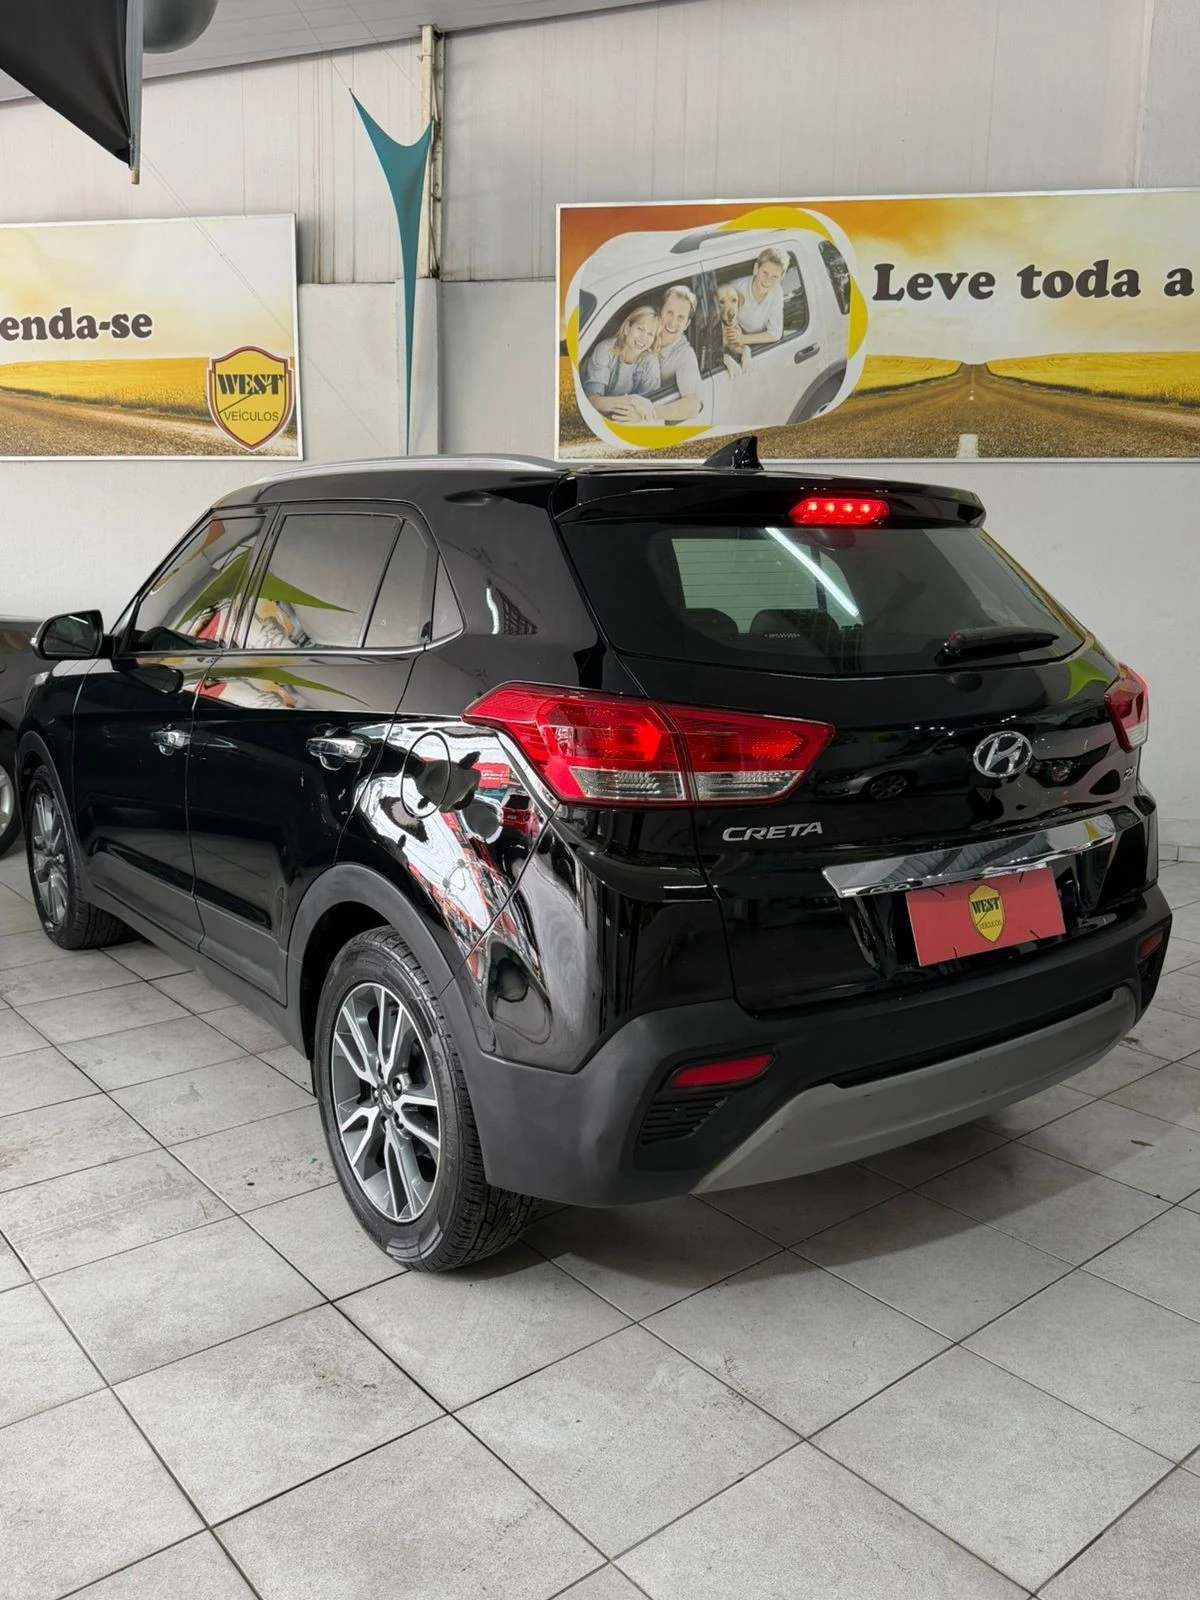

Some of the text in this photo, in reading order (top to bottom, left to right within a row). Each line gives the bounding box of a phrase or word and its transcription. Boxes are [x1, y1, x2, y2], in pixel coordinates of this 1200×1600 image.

[872, 259, 1195, 301] Leve toda a
[0, 306, 153, 341] enda-se
[217, 373, 284, 395] WEST
[223, 409, 280, 422] VEÍCULOS
[722, 821, 823, 842] CRETA
[971, 896, 1001, 914] WEST
